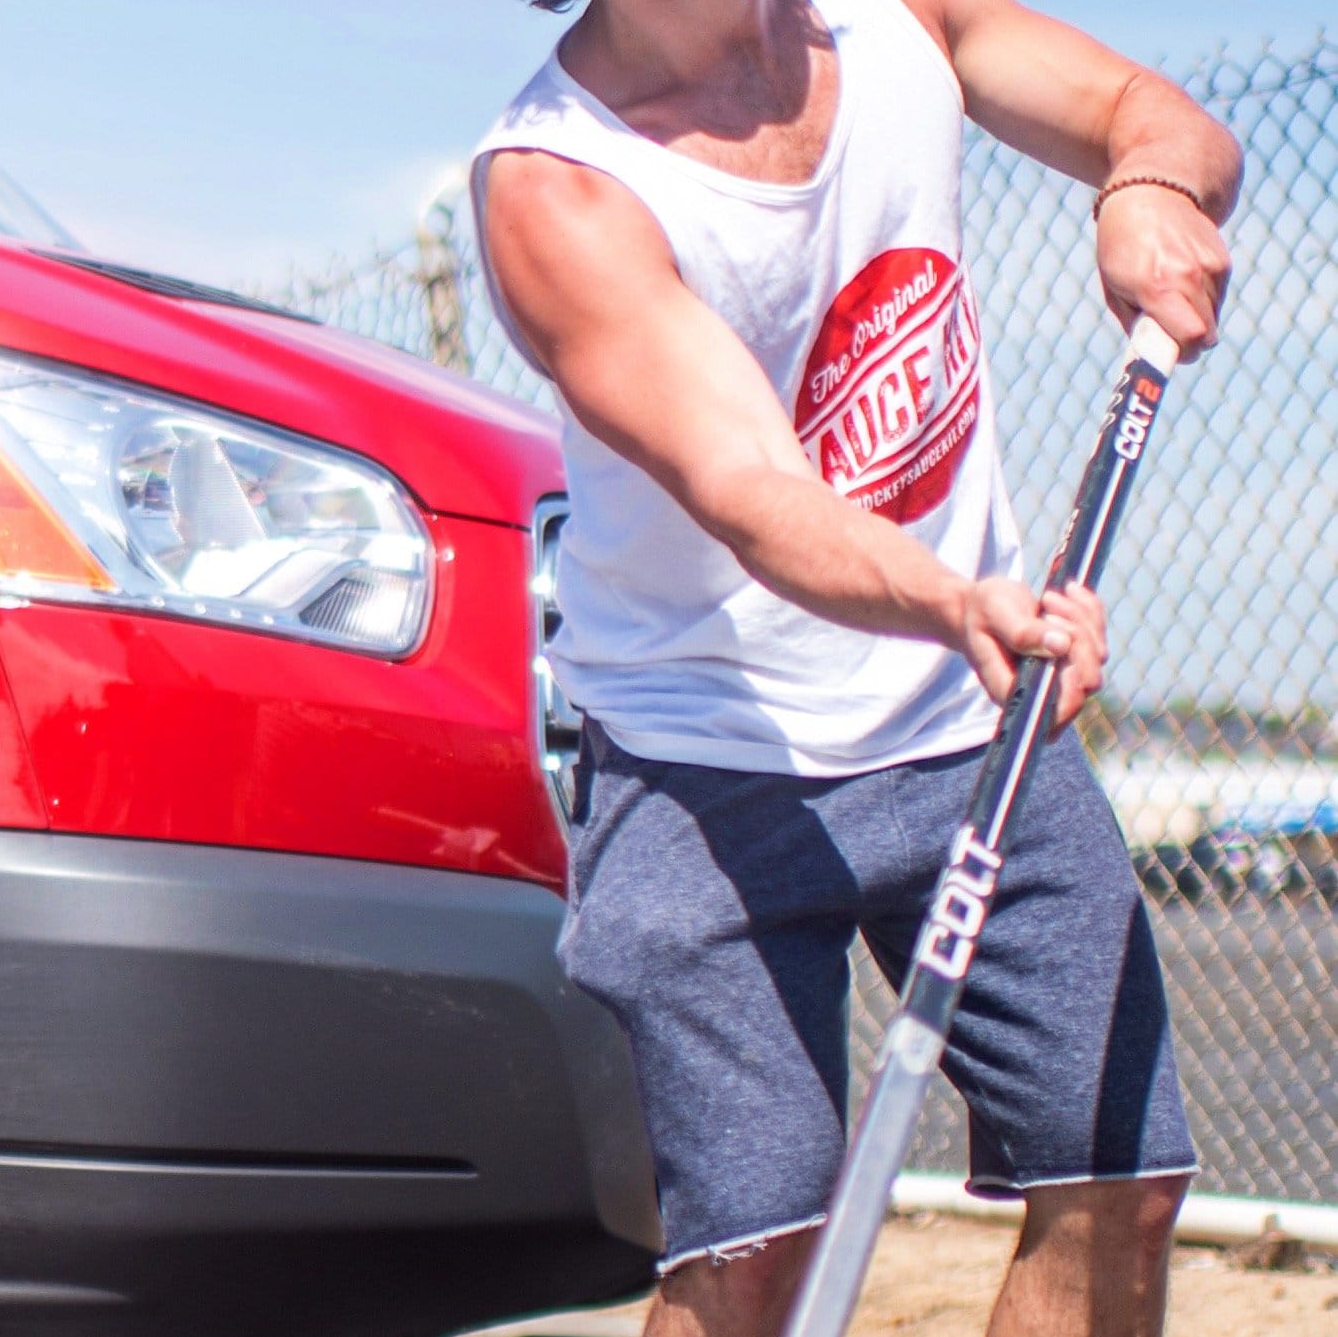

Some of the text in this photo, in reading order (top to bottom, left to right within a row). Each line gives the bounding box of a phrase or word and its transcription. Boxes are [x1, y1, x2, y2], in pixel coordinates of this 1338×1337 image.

[805, 345, 937, 486] AUCE
[811, 353, 851, 404] The
[1113, 394, 1154, 461] COLT
[919, 824, 1004, 980] COLT
